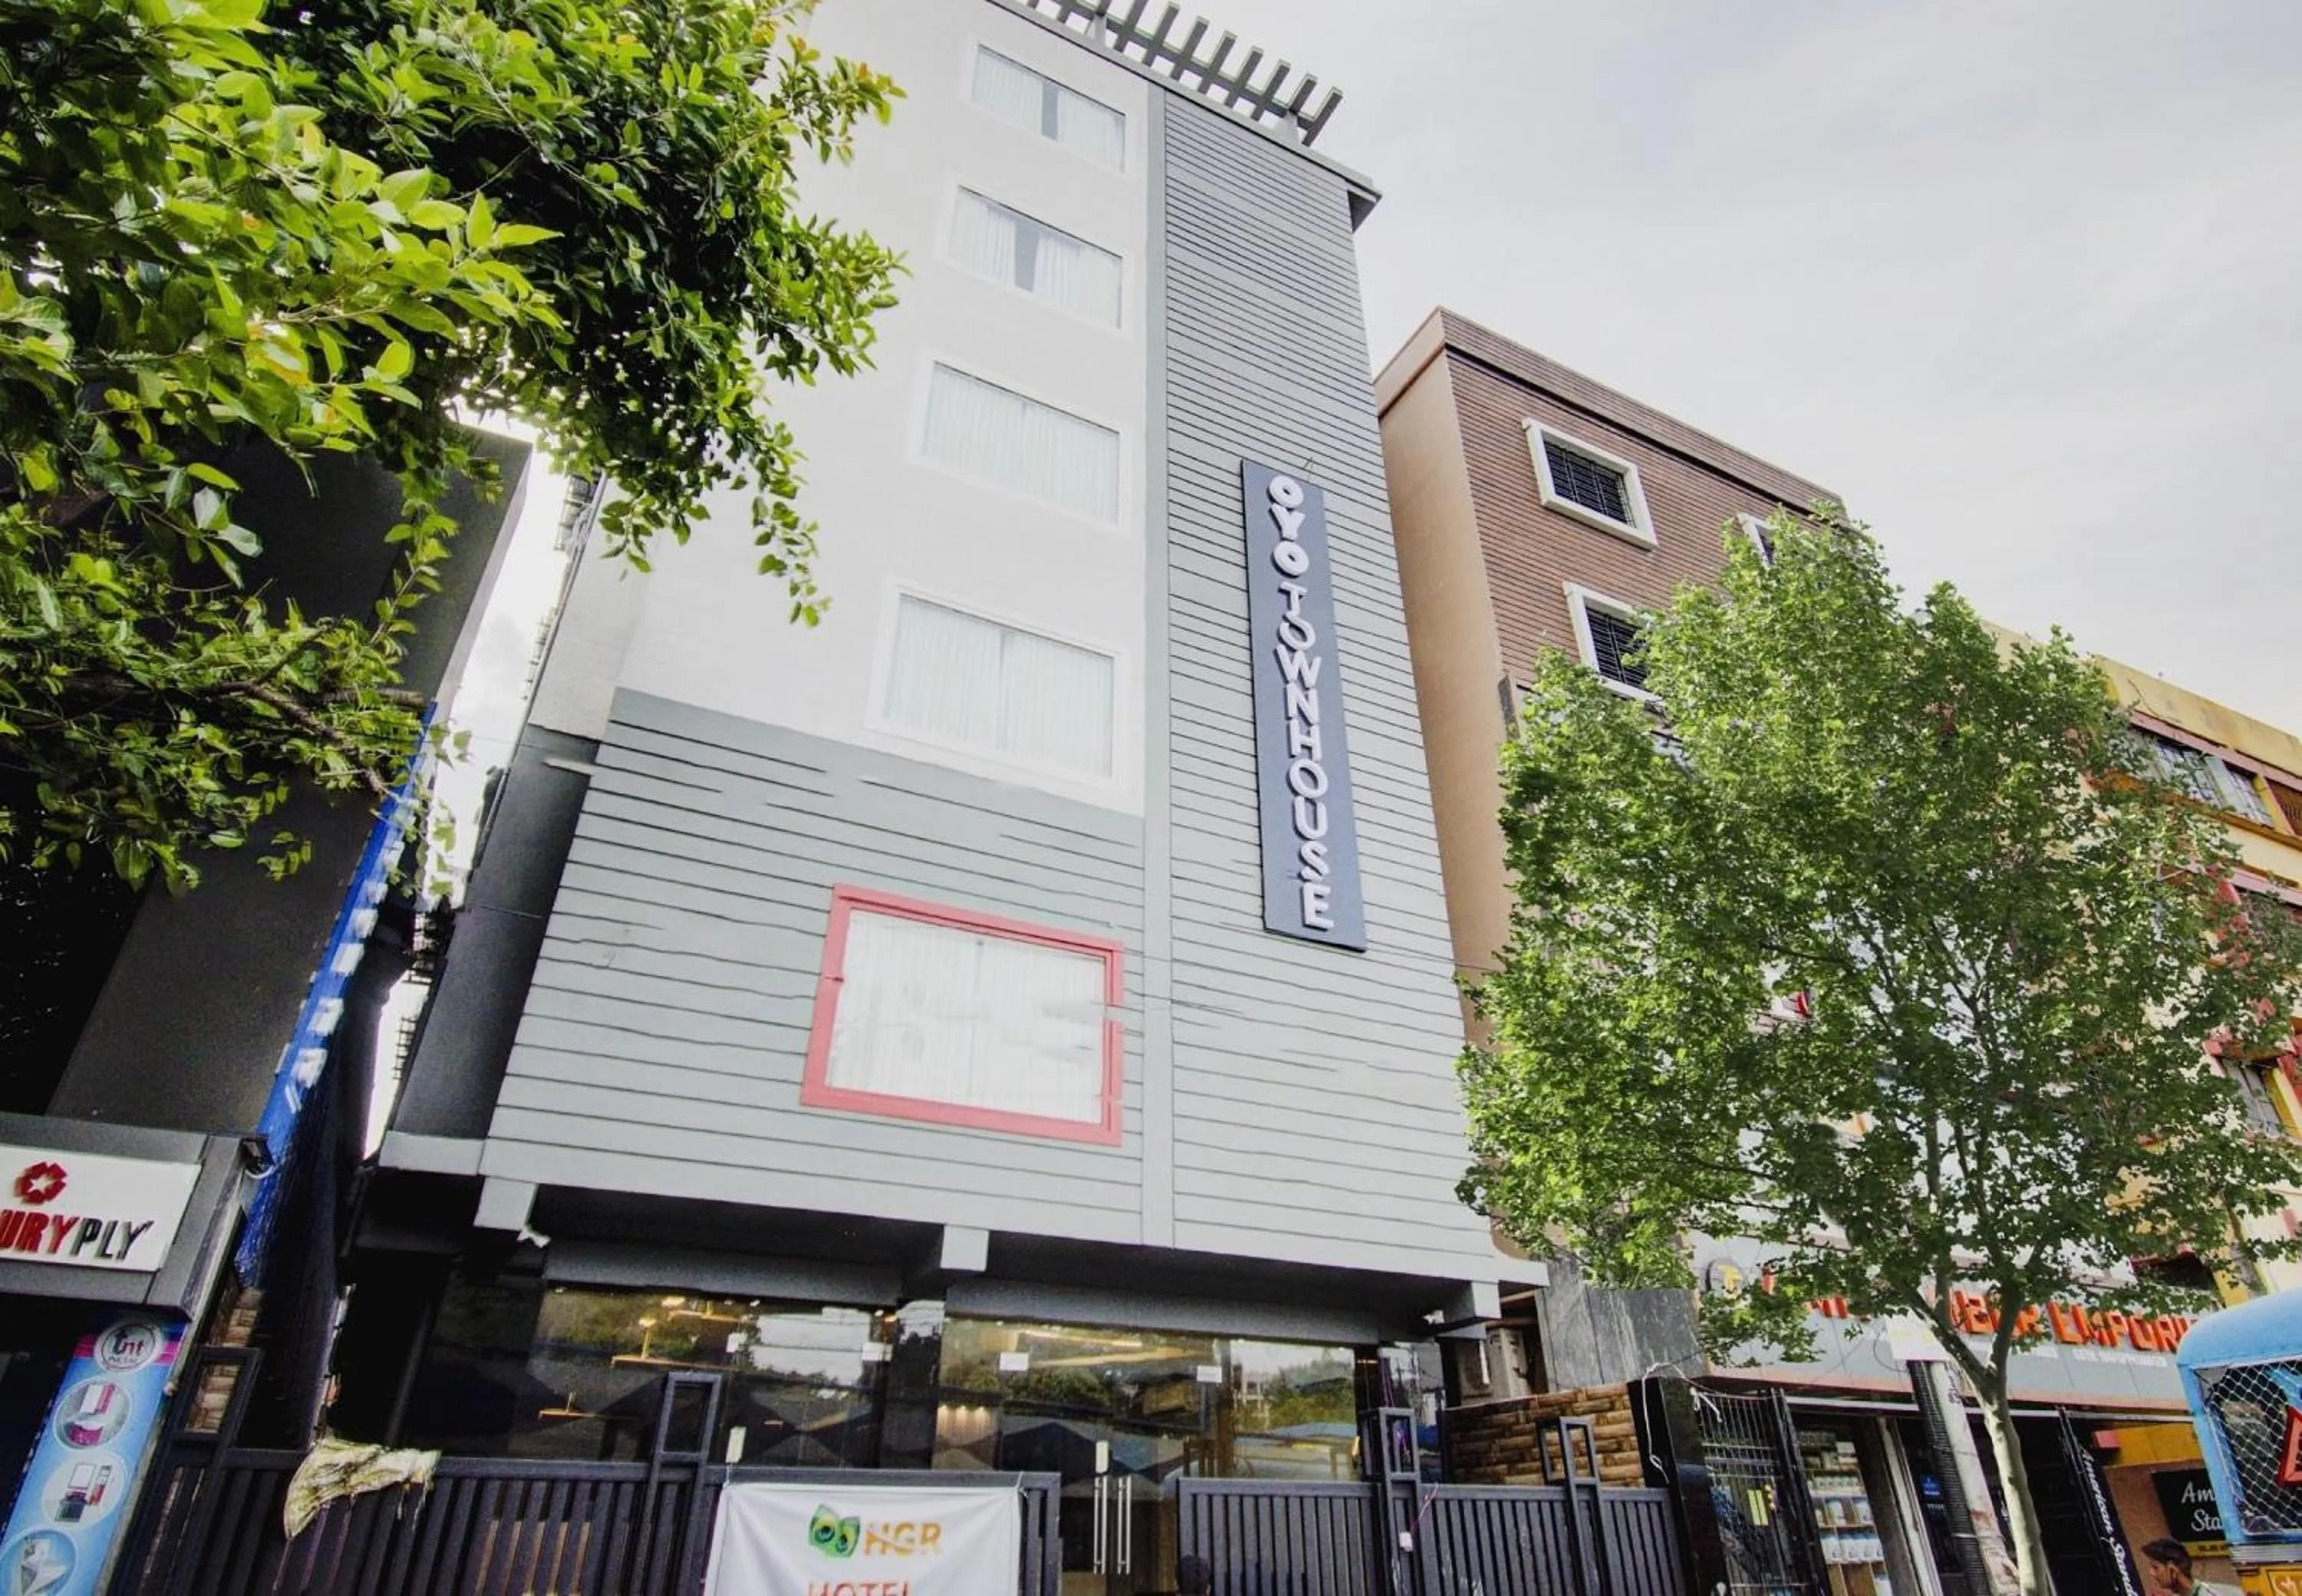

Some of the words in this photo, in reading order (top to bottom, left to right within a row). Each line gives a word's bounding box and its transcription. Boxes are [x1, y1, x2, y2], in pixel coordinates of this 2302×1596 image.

[1268, 474, 1308, 577] OYO
[1275, 580, 1334, 932] TOWNHOUSE
[2046, 1300, 2189, 1353] EMPORI
